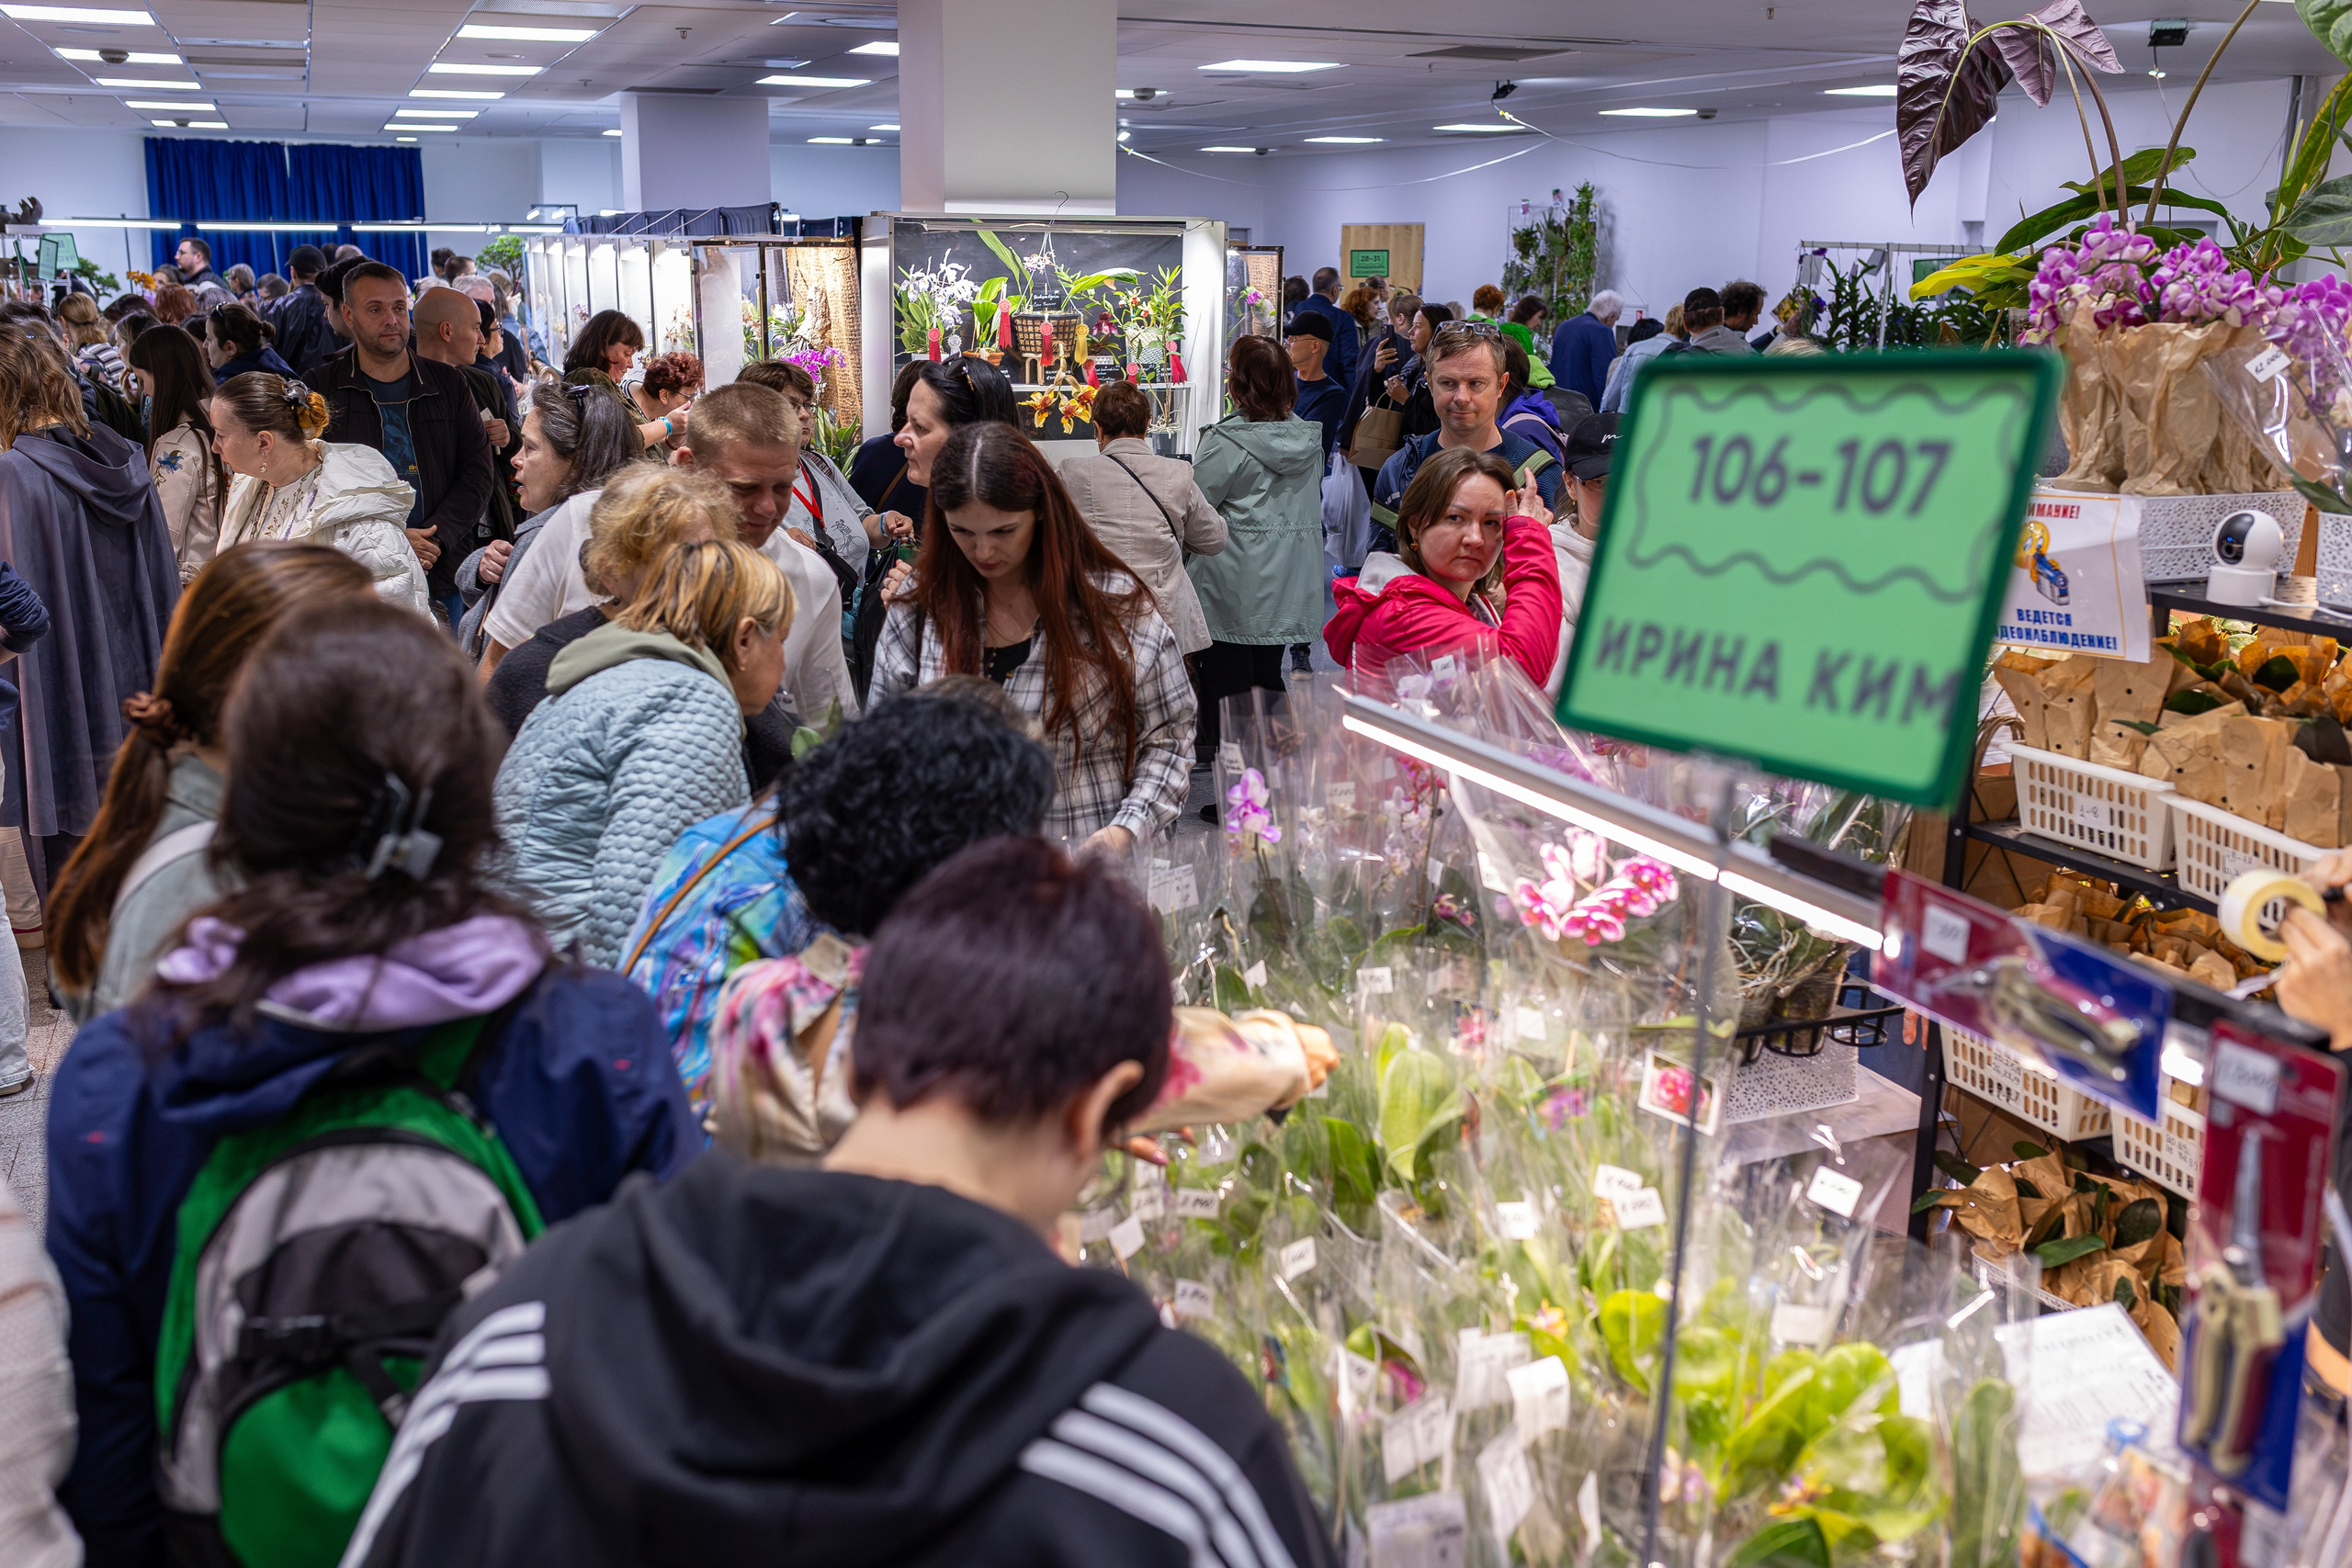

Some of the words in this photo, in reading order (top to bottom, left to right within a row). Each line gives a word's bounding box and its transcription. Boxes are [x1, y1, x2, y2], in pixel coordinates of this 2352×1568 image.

[1688, 434, 1955, 517] 106-107
[1996, 625, 2117, 650] ДЕОНАБЛЮДЕНИЕ!
[2017, 608, 2072, 626] ВЕДЕТСЯ
[1594, 615, 1781, 705] ИРИНА
[1805, 647, 1969, 731] КИМ
